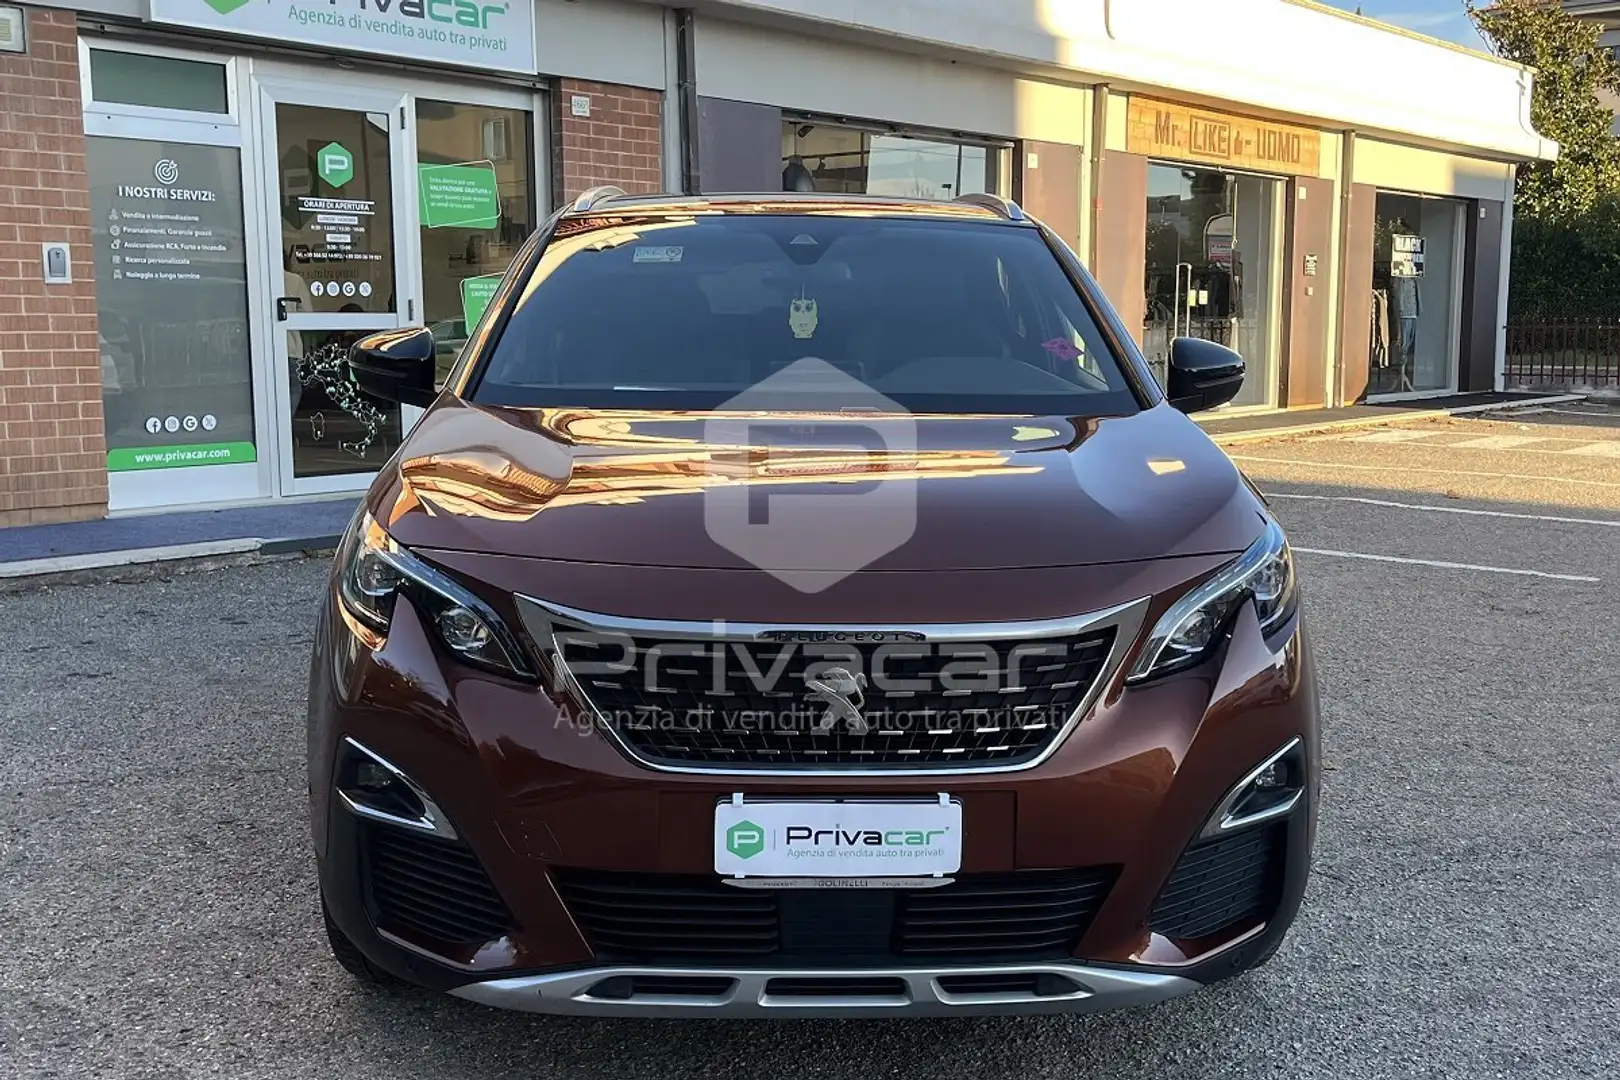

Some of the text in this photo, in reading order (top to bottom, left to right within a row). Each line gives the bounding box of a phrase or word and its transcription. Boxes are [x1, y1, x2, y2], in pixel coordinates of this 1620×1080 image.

[288, 5, 508, 51] Agenzia di vendita auto tra privati
[1155, 110, 1181, 147] Mr.
[1193, 121, 1229, 154] LIKE
[1256, 127, 1301, 164] UOMO
[118, 186, 216, 201] I NOSTRI SERVIZI:
[303, 200, 325, 209] ORARI
[335, 202, 370, 212] APERTURA
[135, 447, 230, 463] www.privacar.com
[773, 632, 901, 642] PEUGEOT
[786, 824, 945, 846] Privacar
[787, 849, 945, 860] Agenzia di vendita auto tra privati
